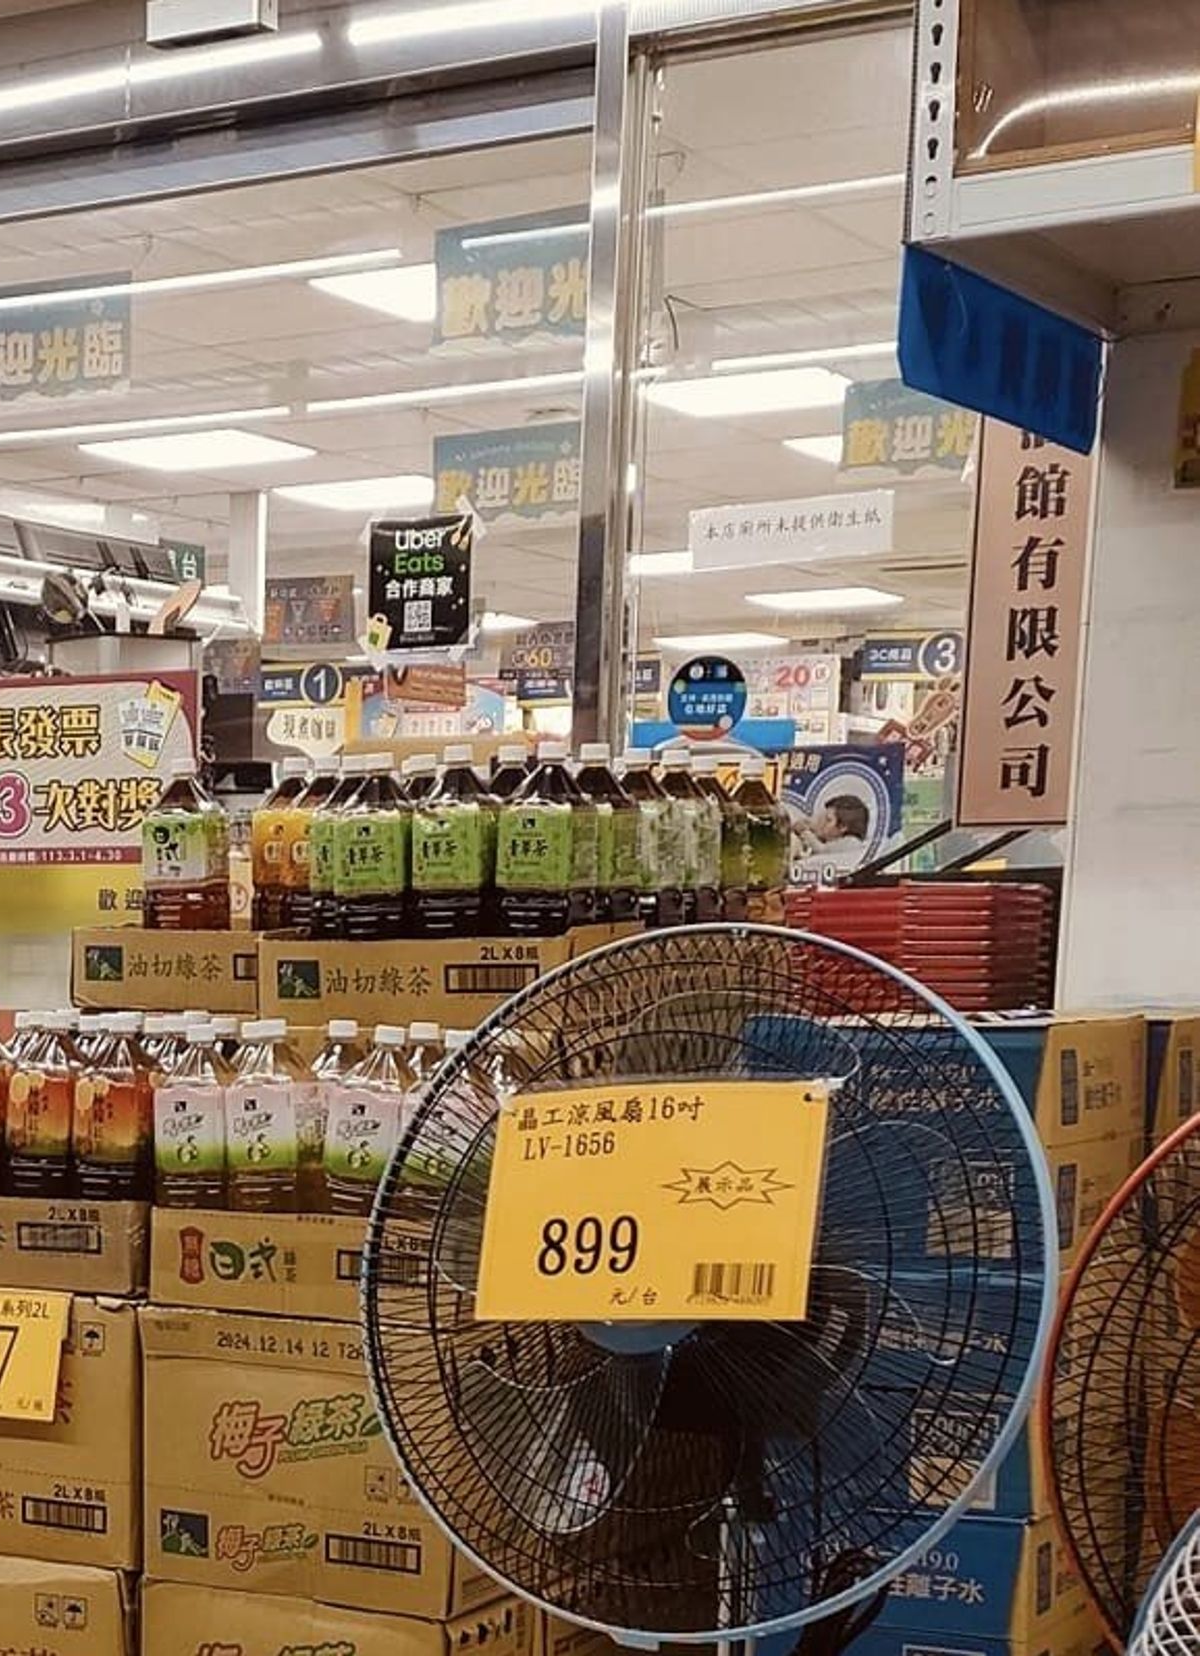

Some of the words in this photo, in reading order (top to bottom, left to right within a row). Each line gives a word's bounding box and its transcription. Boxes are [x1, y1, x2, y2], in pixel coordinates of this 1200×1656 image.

[394, 528, 447, 550] Uber
[394, 553, 444, 574] Eats
[385, 577, 453, 599] 合作商家
[1000, 430, 1071, 799] 館有限公司
[934, 638, 956, 672] 3
[312, 668, 326, 700] 1
[128, 953, 224, 982] 油切綠茶
[326, 967, 433, 997] 油切綠茶
[524, 1131, 616, 1161] LV-1656
[695, 1175, 755, 1194] 展示品
[537, 1215, 640, 1277] 899
[210, 1393, 366, 1480] 梅子綠茶
